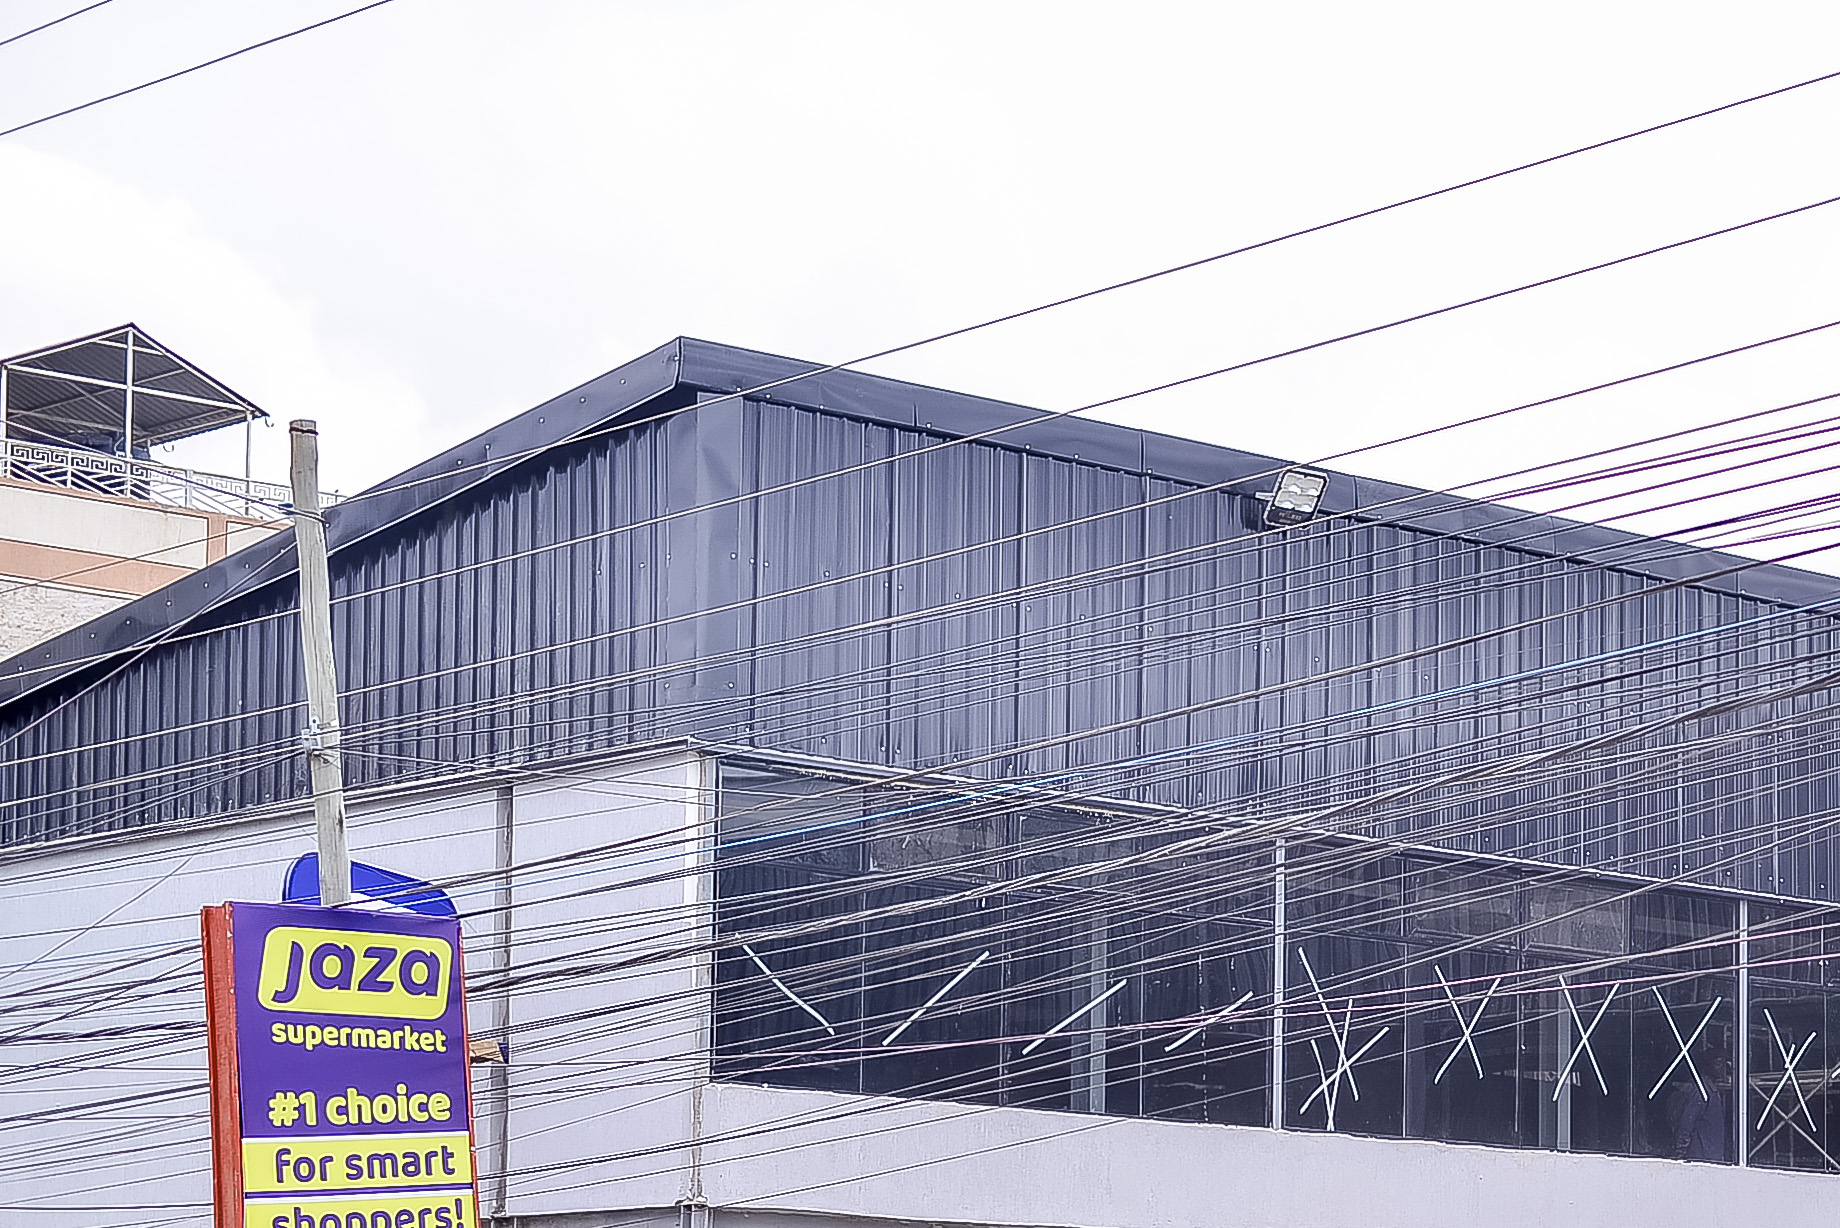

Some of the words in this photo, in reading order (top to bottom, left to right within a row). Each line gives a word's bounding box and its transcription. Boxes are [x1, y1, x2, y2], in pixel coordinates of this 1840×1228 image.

[271, 1022, 447, 1053] supermarket
[268, 1091, 318, 1127] #1
[325, 1083, 452, 1125] choice
[275, 1147, 334, 1184] for
[345, 1145, 456, 1180] smart
